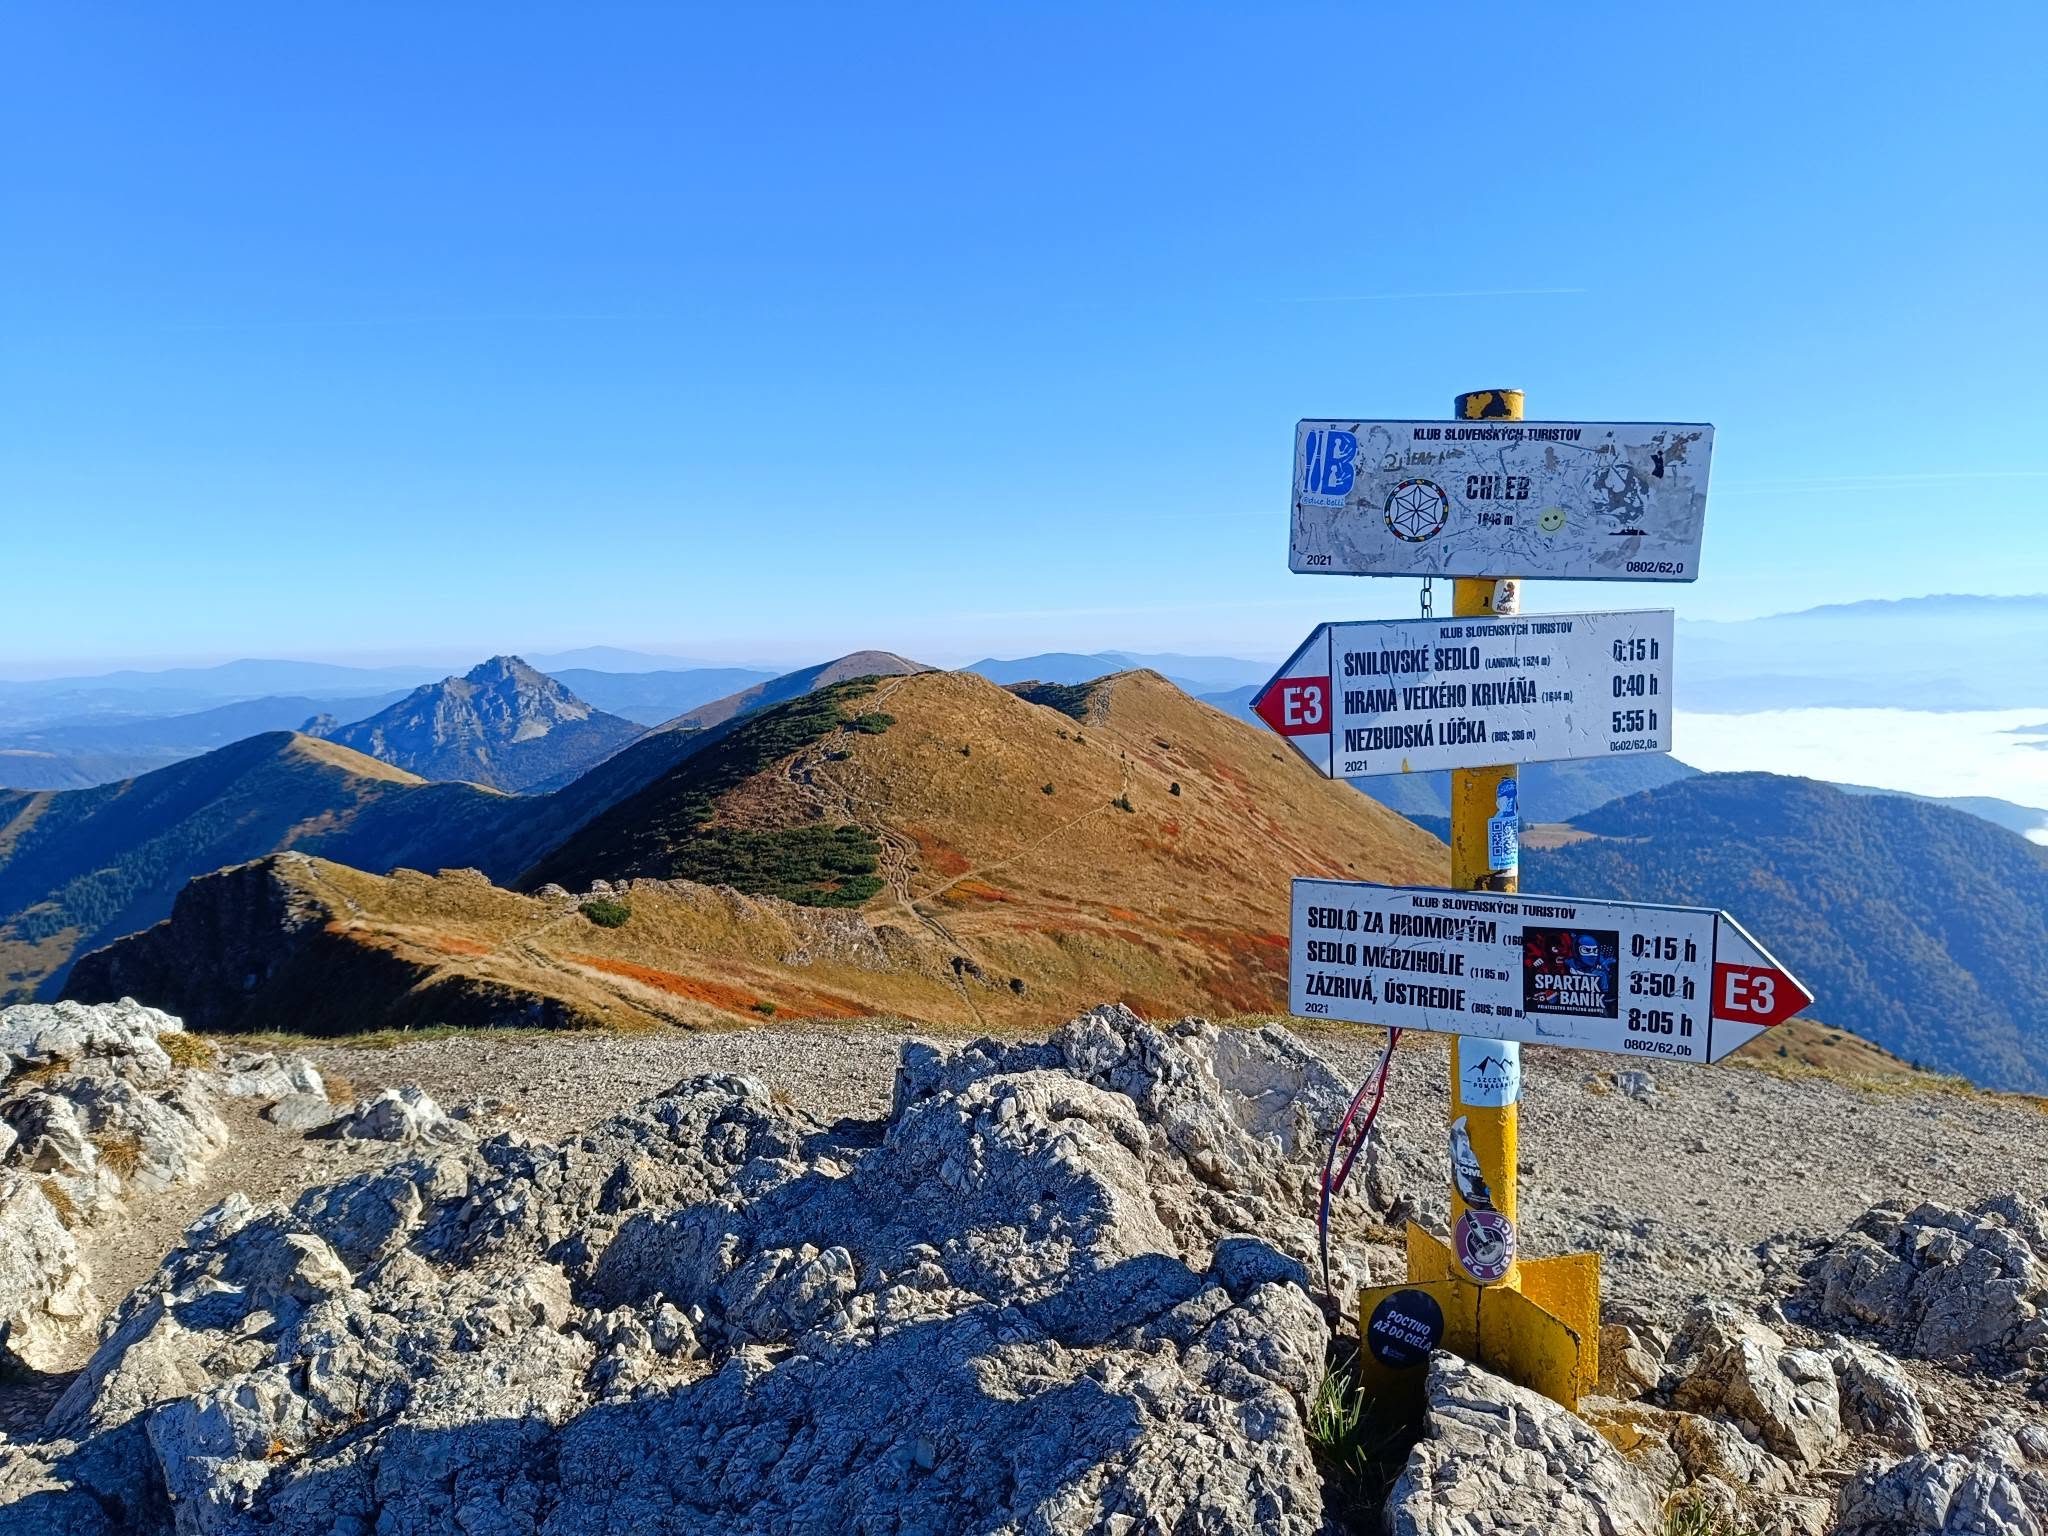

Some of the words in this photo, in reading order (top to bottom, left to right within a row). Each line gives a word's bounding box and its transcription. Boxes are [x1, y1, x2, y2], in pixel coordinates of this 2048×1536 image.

[1413, 428, 1441, 441] KLUB
[1445, 426, 1524, 441] SLOVENSKÝCH
[1527, 428, 1582, 441] TURISTOV
[1466, 475, 1530, 500] CHLEB
[1504, 515, 1513, 525] m
[1307, 555, 1332, 566] 2021
[1626, 562, 1684, 575] 0802/62,0
[1440, 627, 1463, 639] KLUB
[1466, 622, 1528, 638] SLOVENSKÝCH
[1531, 622, 1573, 635] TURISTOV
[1344, 644, 1429, 676] SNILOVSKÉ
[1434, 646, 1480, 671] SEDLO
[1522, 656, 1540, 667] 1524
[1613, 639, 1646, 662] 0:15
[1650, 638, 1659, 660] h
[1344, 688, 1398, 715] HRANA
[1402, 681, 1467, 711] VEĽKÉHO
[1472, 676, 1537, 707] KRIVÁŇA
[1612, 674, 1645, 698] 0:40
[1649, 673, 1658, 696] h
[1283, 686, 1323, 726] E3
[1612, 709, 1645, 733] 5:55
[1649, 708, 1657, 731] h
[1345, 719, 1434, 752] NEZBUDSKÁ
[1439, 717, 1487, 746] LÚČKA
[1610, 739, 1657, 751] 0802/62,0a
[1345, 760, 1368, 772] 2021
[1412, 896, 1439, 908] KLUB
[1442, 898, 1518, 915] SLOVENSKÝCH
[1521, 904, 1577, 919] TURISTOV
[1308, 906, 1358, 932] SEDLO
[1363, 911, 1384, 934] ZA
[1390, 913, 1497, 944] HROMOVÝM
[1503, 935, 1523, 946] (160
[1631, 933, 1678, 961] 0:15
[1684, 938, 1697, 962] h
[1307, 940, 1357, 966] SEDLO
[1363, 945, 1465, 976] MEDZIHOLIE
[1470, 967, 1496, 980] (1185
[1497, 970, 1510, 982] m)
[1306, 971, 1378, 1005] ZÁZRIVÁ,
[1384, 977, 1465, 1011] ÚSTREDIE
[1472, 1003, 1494, 1016] (BUS;
[1535, 974, 1601, 992] SPARTAK
[1630, 971, 1676, 998] 3:50
[1682, 976, 1695, 1000] h
[1724, 971, 1775, 1014] E3
[1305, 1003, 1328, 1013] 2021
[1560, 990, 1605, 1008] BANÍK
[1628, 1008, 1674, 1035] 8:05
[1680, 1013, 1693, 1037] h
[1624, 1038, 1692, 1057] 0802/62,0b
[1455, 1162, 1483, 1178] POM
[1462, 1255, 1483, 1276] FC
[1373, 1320, 1391, 1333] AŽ
[1388, 1325, 1404, 1339] DO
[1387, 1310, 1431, 1335] POCTIVO
